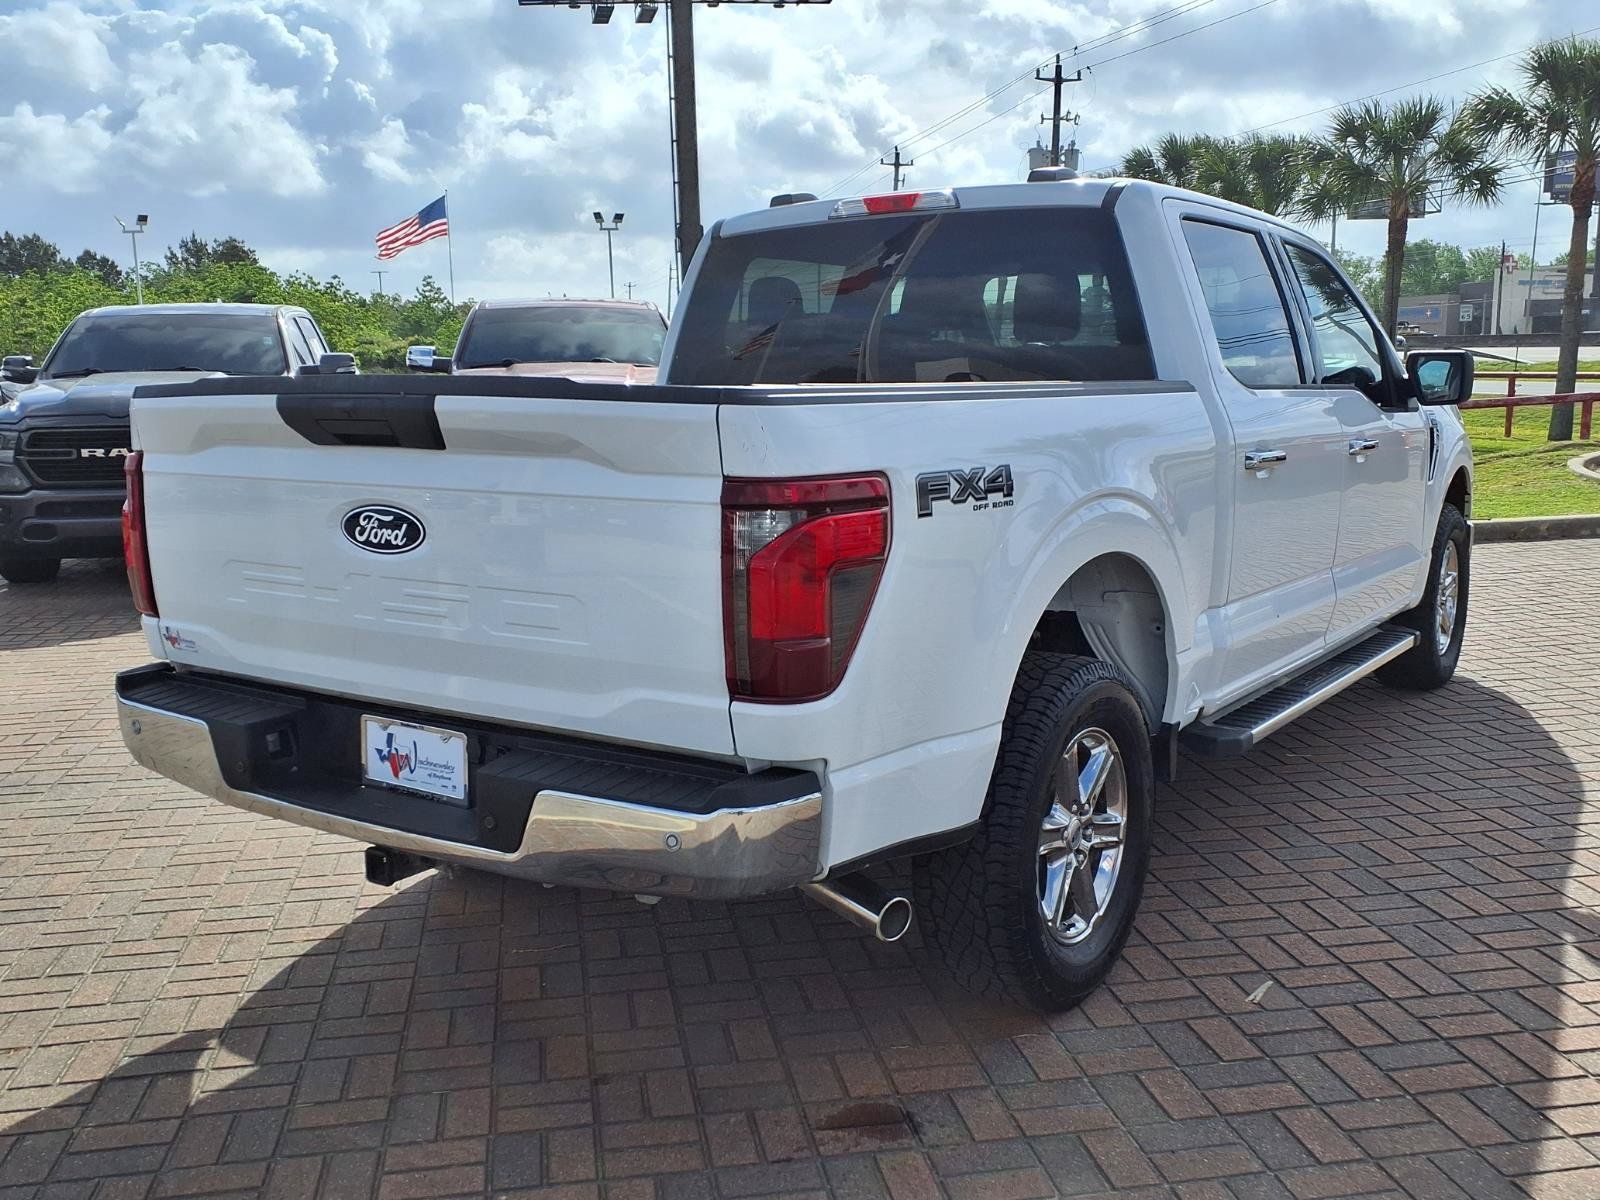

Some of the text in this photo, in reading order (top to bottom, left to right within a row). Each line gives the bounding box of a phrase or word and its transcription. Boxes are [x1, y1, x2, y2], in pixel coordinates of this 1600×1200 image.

[80, 448, 129, 457] RA
[915, 464, 1014, 519] FX4
[973, 500, 1014, 511] OFF ROAD
[355, 512, 407, 546] Ford
